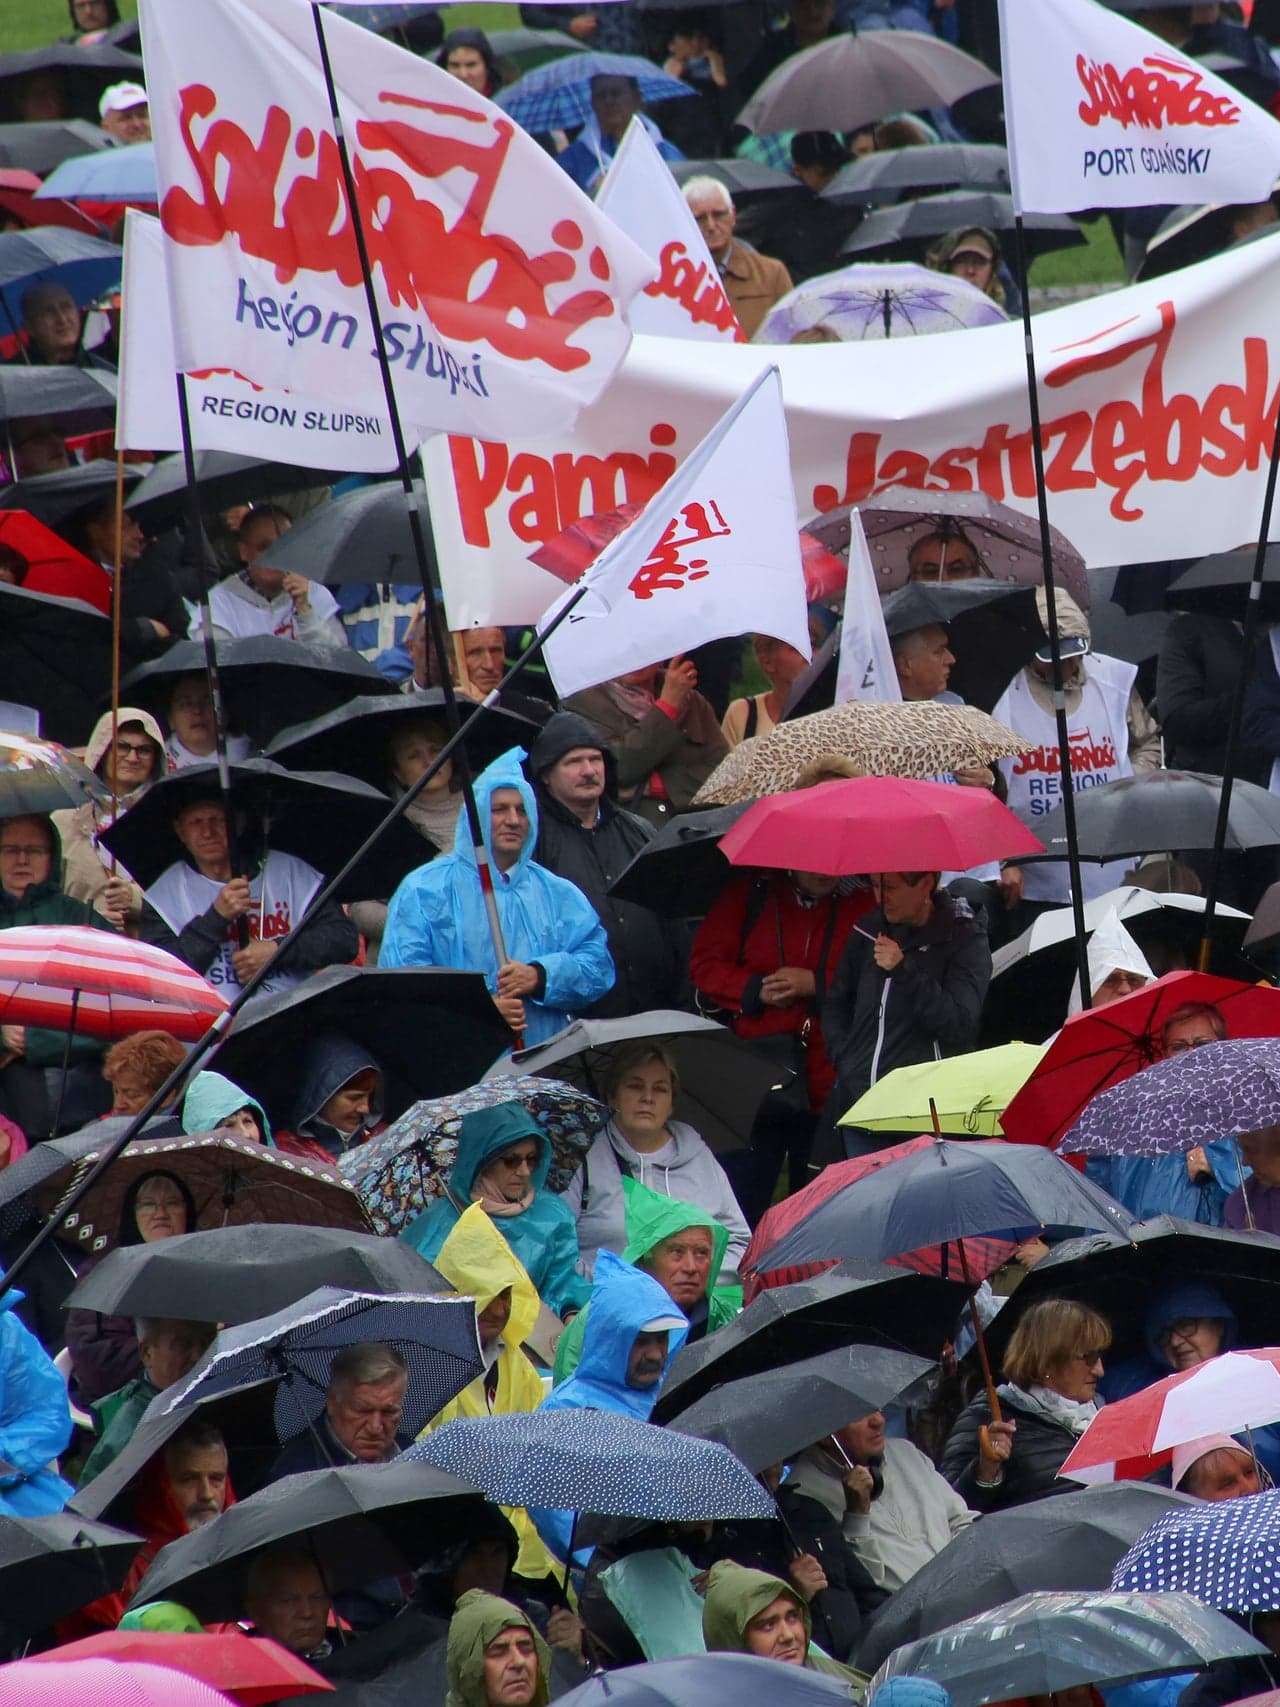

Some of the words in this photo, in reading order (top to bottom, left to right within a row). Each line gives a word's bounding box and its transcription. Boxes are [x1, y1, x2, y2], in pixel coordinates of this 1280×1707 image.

[1083, 148, 1136, 178] PORT
[1140, 142, 1211, 174] GDAŃSKI
[202, 396, 297, 428] REGION
[303, 411, 381, 435] SŁUPSKI
[1028, 773, 1109, 797] REION
